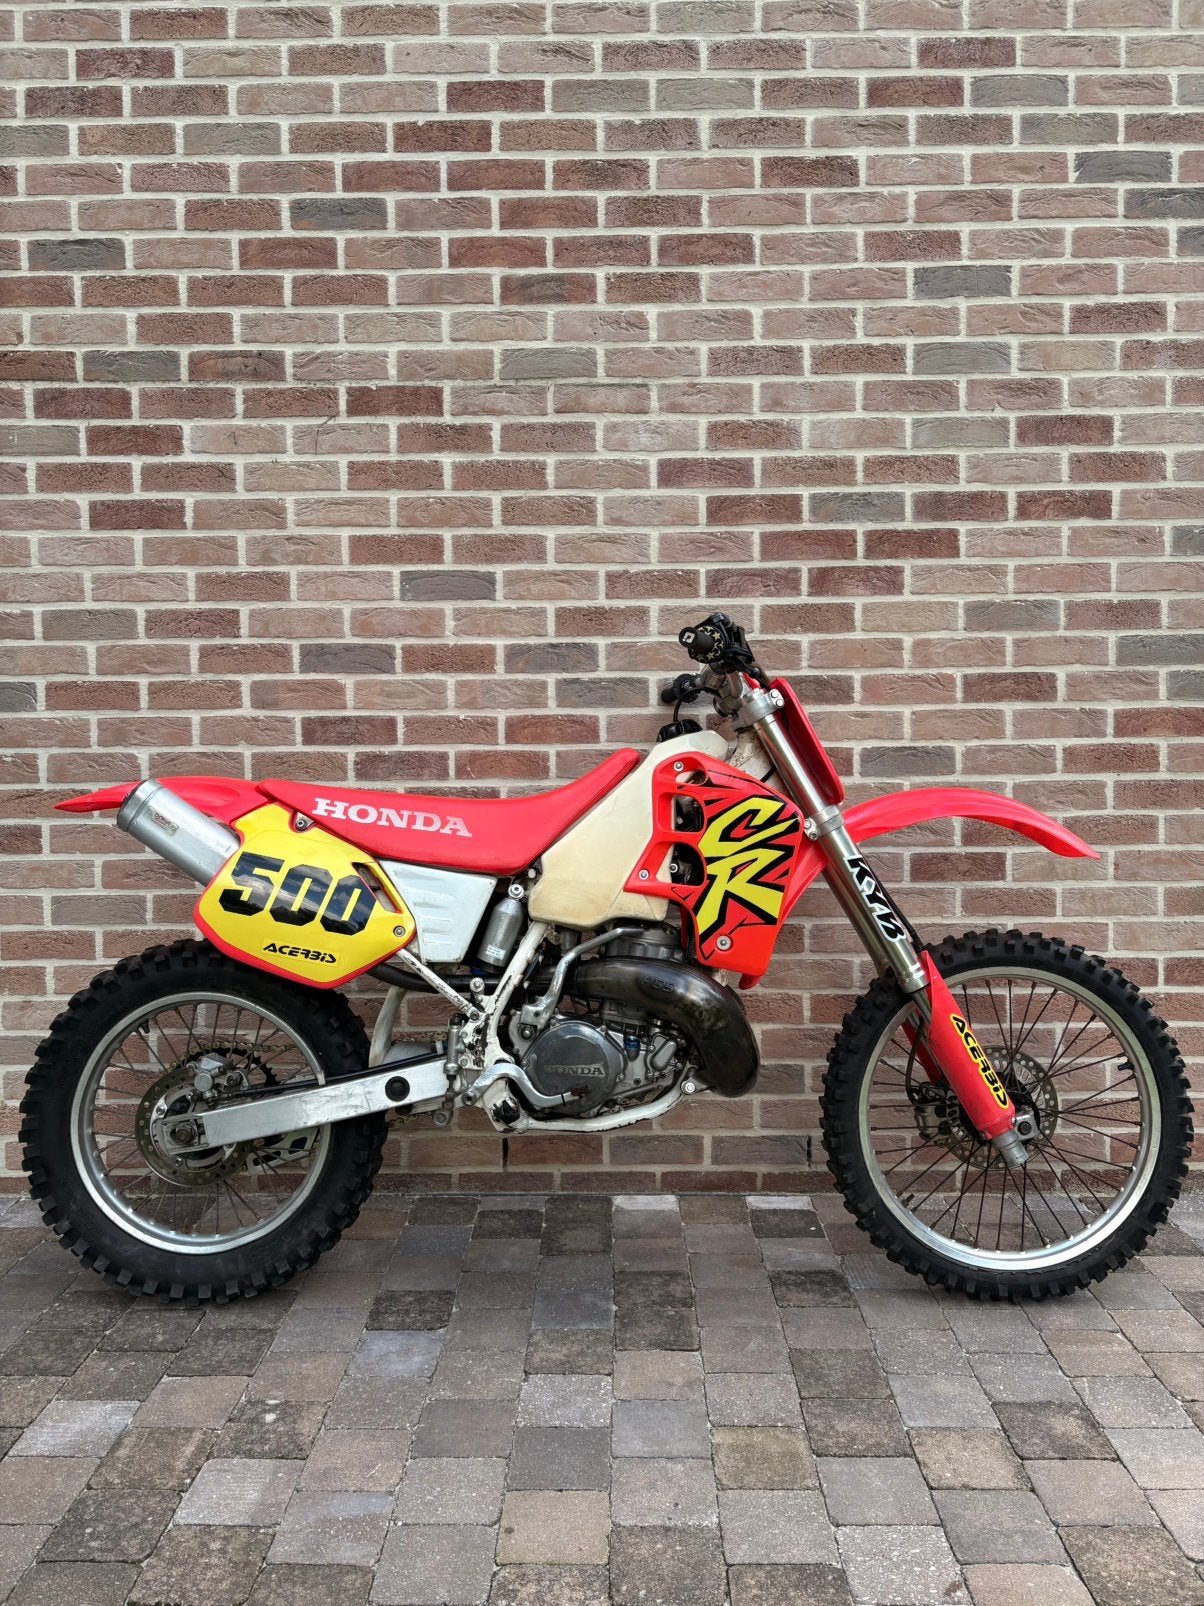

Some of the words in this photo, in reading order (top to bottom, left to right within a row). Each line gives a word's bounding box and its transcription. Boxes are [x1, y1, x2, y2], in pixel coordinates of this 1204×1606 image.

[312, 797, 473, 838] HONDA
[219, 851, 377, 936] 500
[843, 855, 906, 942] KYB
